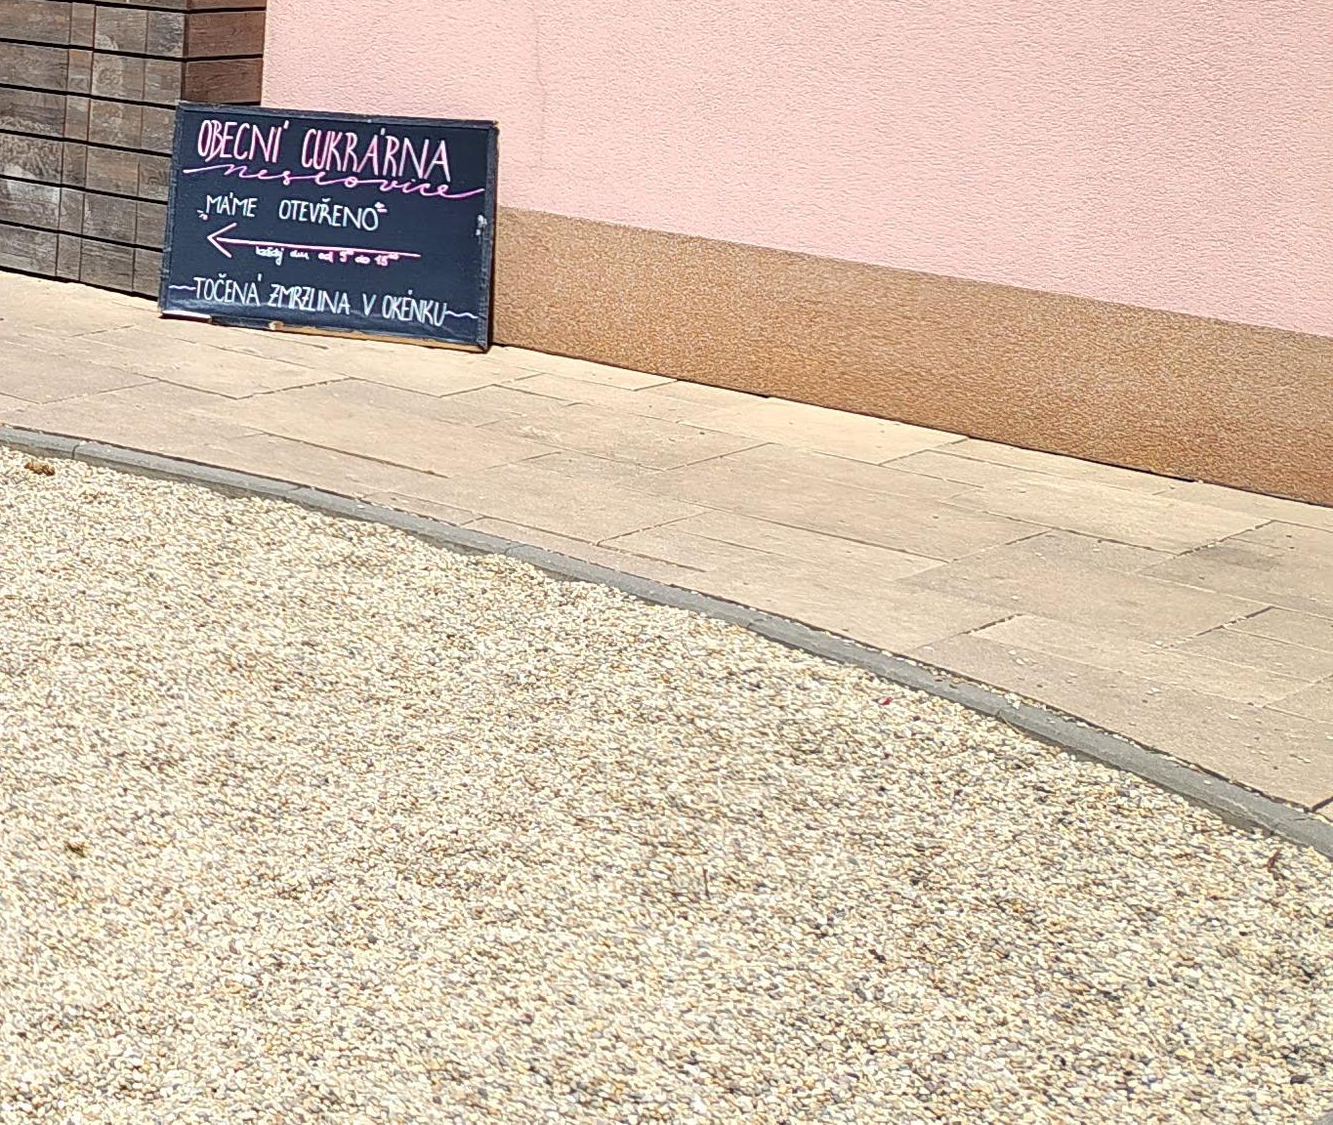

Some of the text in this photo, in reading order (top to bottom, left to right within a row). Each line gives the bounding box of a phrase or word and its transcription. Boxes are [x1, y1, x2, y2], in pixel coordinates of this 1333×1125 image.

[197, 119, 451, 183] OBECNÍ CUKRÁRNA
[206, 192, 379, 231] MÁME OTEVŘENO
[193, 273, 448, 326] TOČENÁ ZMRZLINA V OKÉNKU
